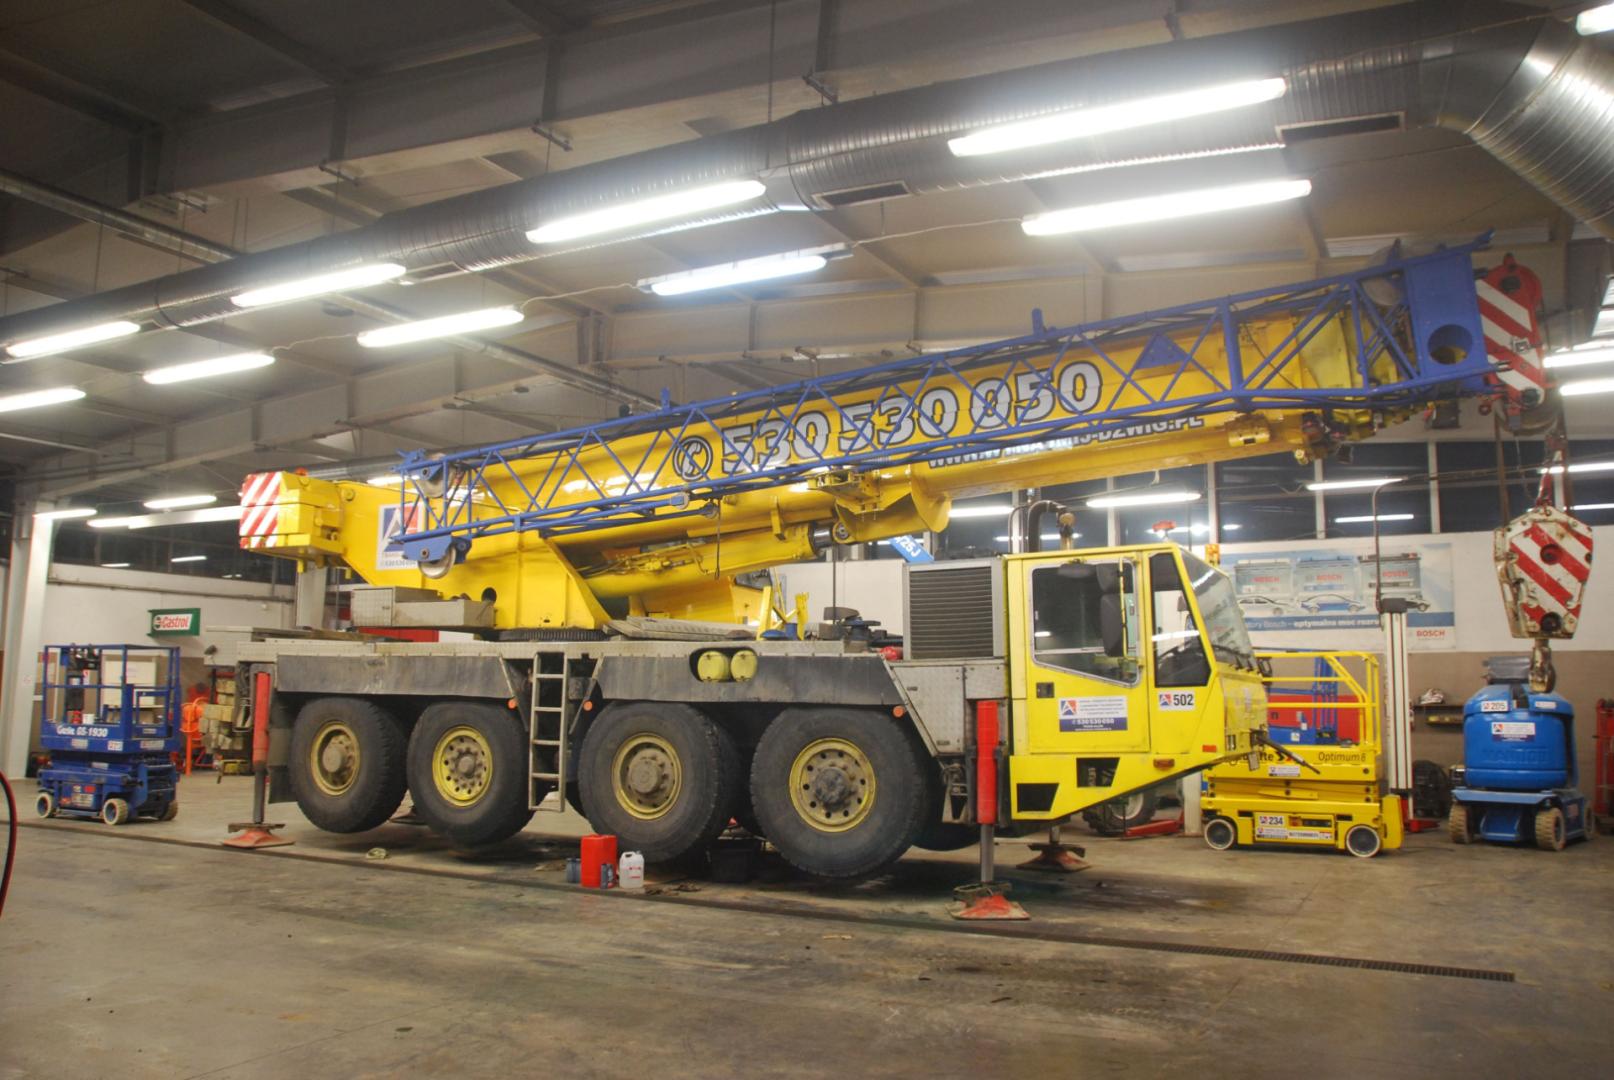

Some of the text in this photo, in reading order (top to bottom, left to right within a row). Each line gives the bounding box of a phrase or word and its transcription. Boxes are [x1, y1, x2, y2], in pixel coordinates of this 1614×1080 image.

[722, 360, 1104, 474] 530 530 050
[161, 615, 189, 629] Castrol
[1416, 629, 1446, 638] BOSCH
[1173, 694, 1194, 706] 502
[1318, 751, 1360, 764] Optimum
[1269, 816, 1284, 825] 234
